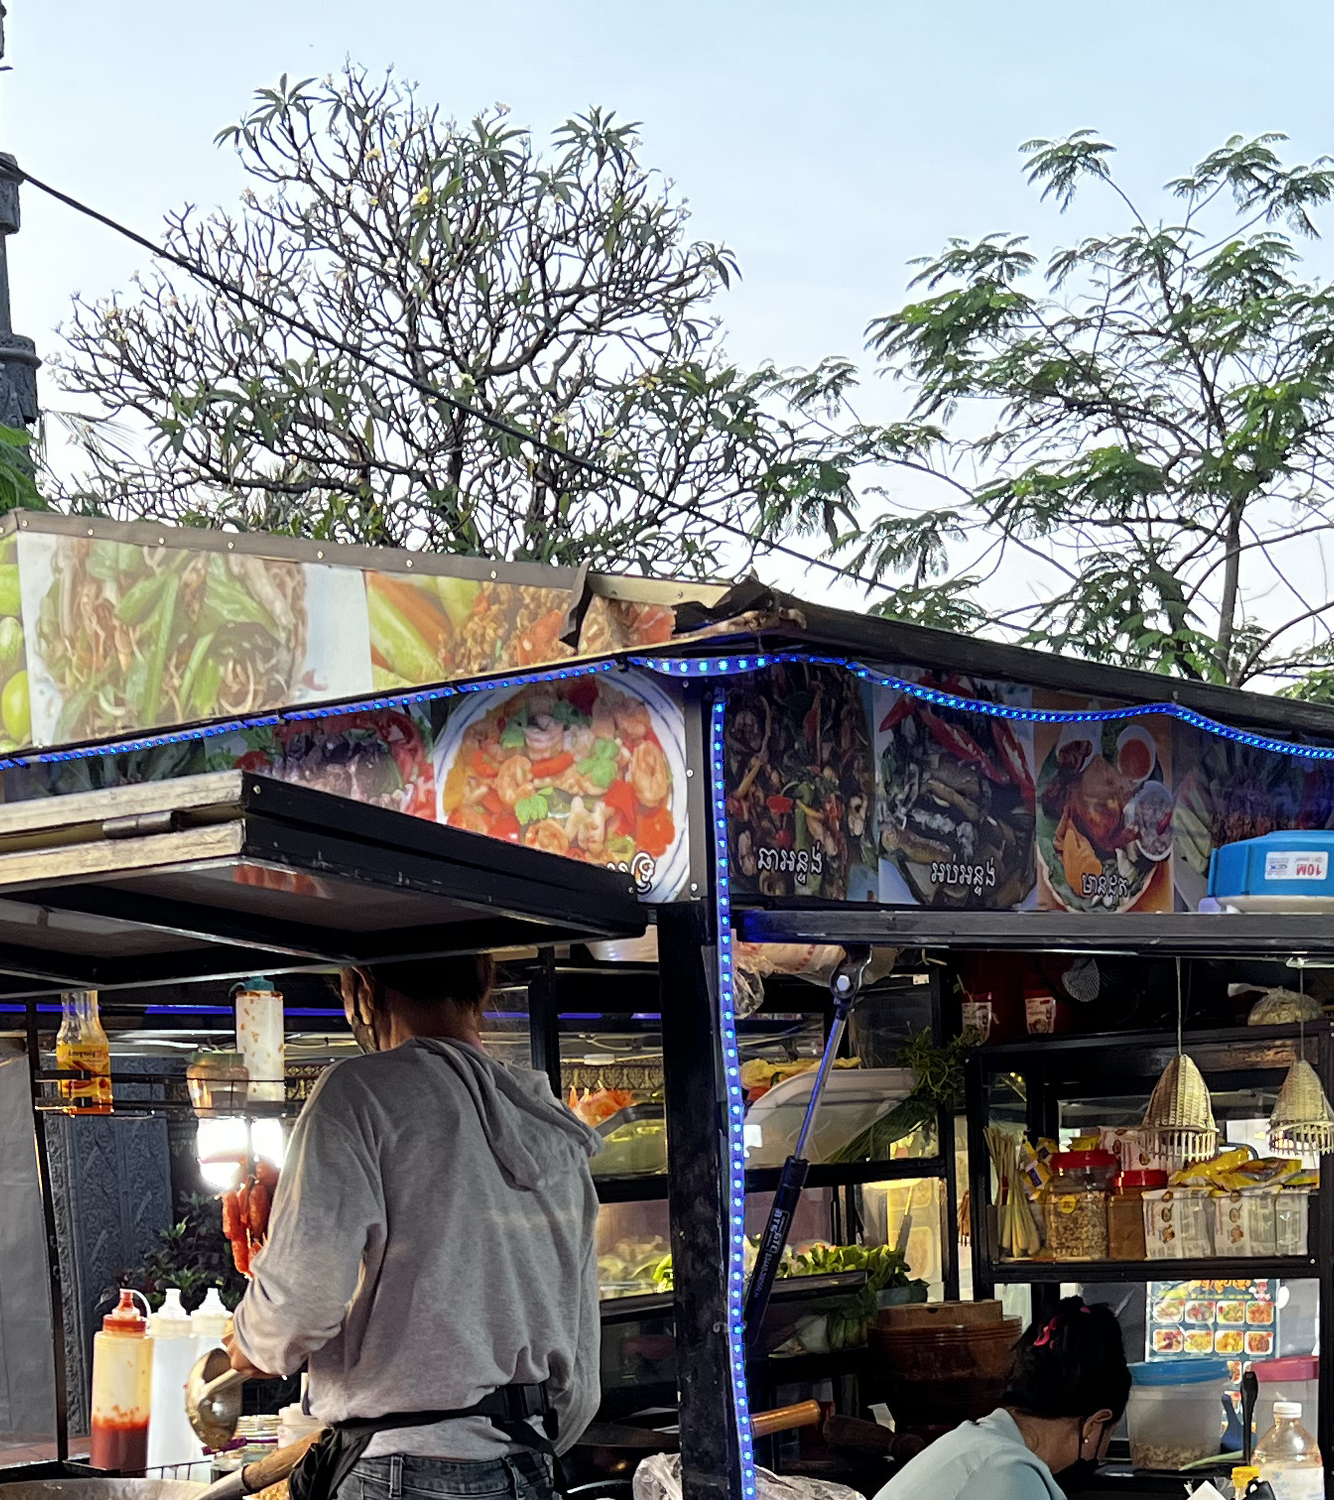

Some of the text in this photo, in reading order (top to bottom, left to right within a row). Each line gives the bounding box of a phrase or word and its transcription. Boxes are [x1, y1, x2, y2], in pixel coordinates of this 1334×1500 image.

[757, 841, 823, 884] ឆាអន្ទង់
[931, 853, 996, 897] អប់អន្ទង់
[1295, 863, 1323, 876] 10M
